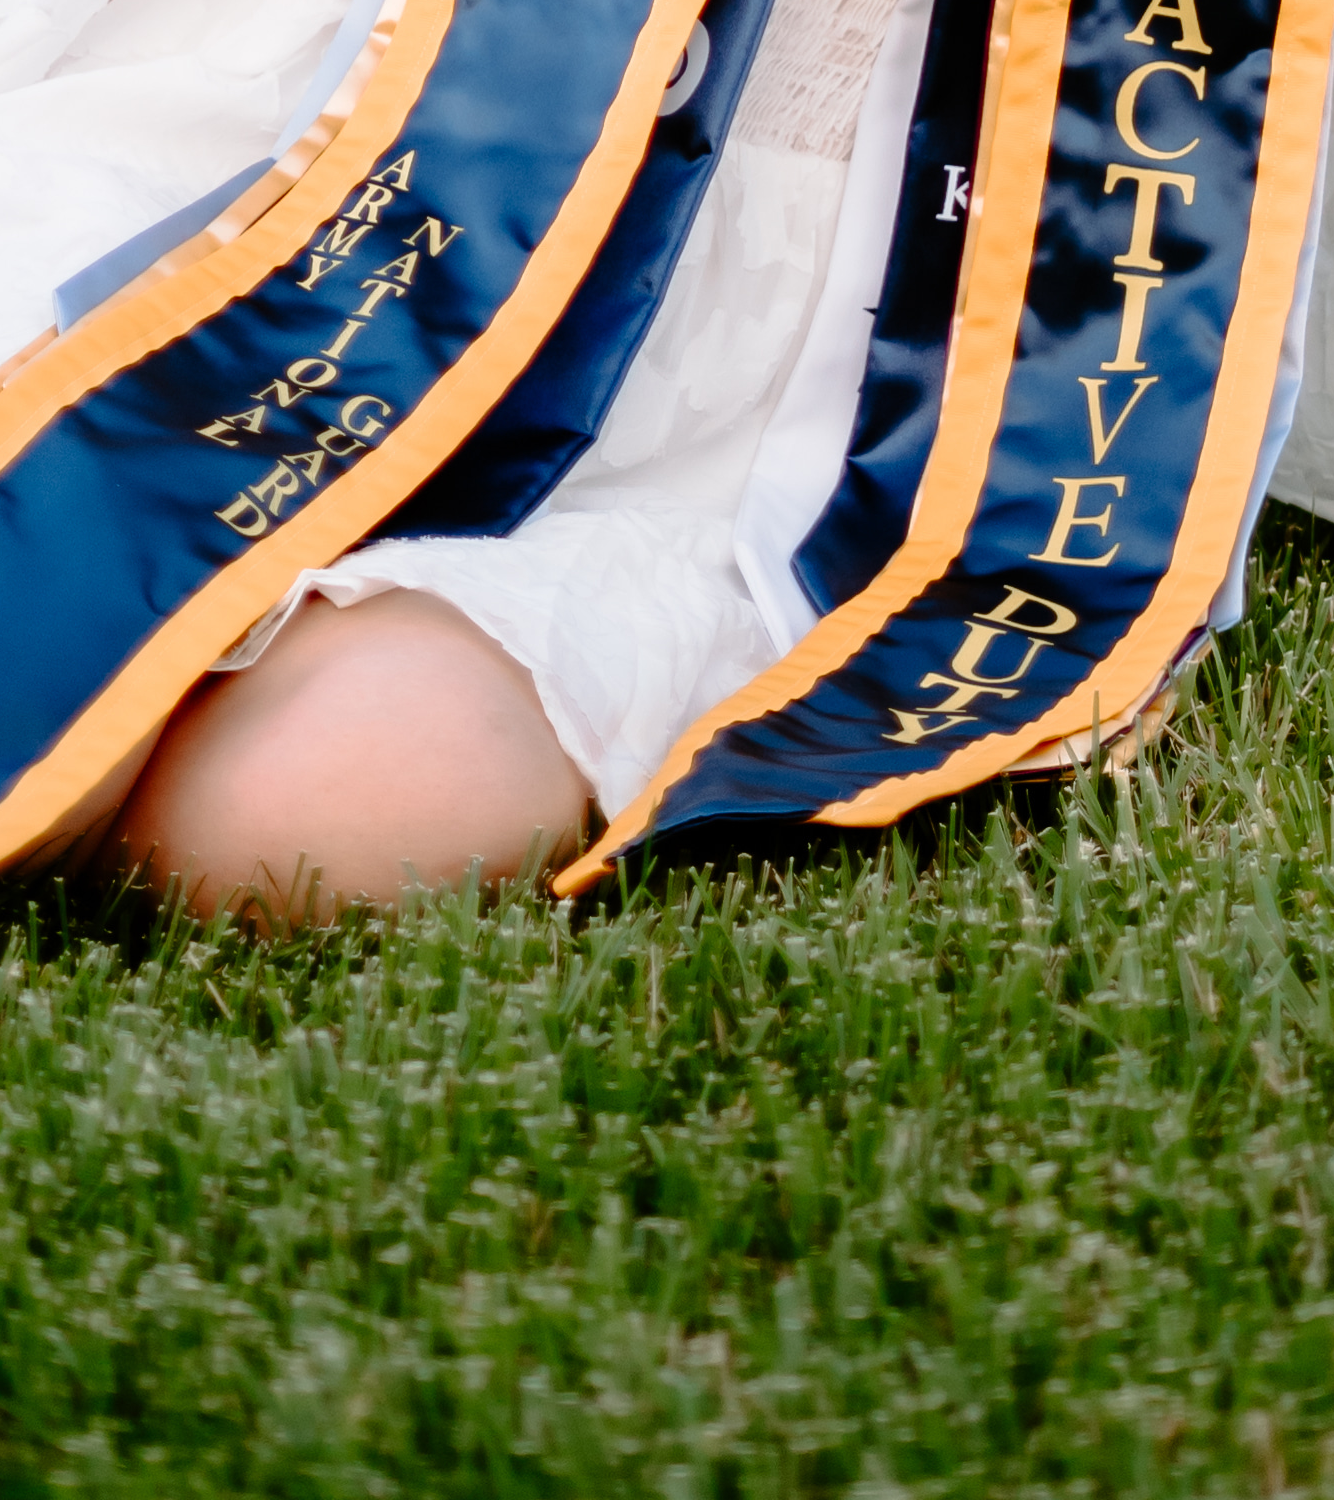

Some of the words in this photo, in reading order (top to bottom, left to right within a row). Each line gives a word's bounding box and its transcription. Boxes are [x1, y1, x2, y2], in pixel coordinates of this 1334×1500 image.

[295, 150, 415, 291] ARMY
[195, 215, 465, 447] NATIONAL
[213, 394, 392, 539] GUARD
[880, 584, 1078, 746] DUTY
